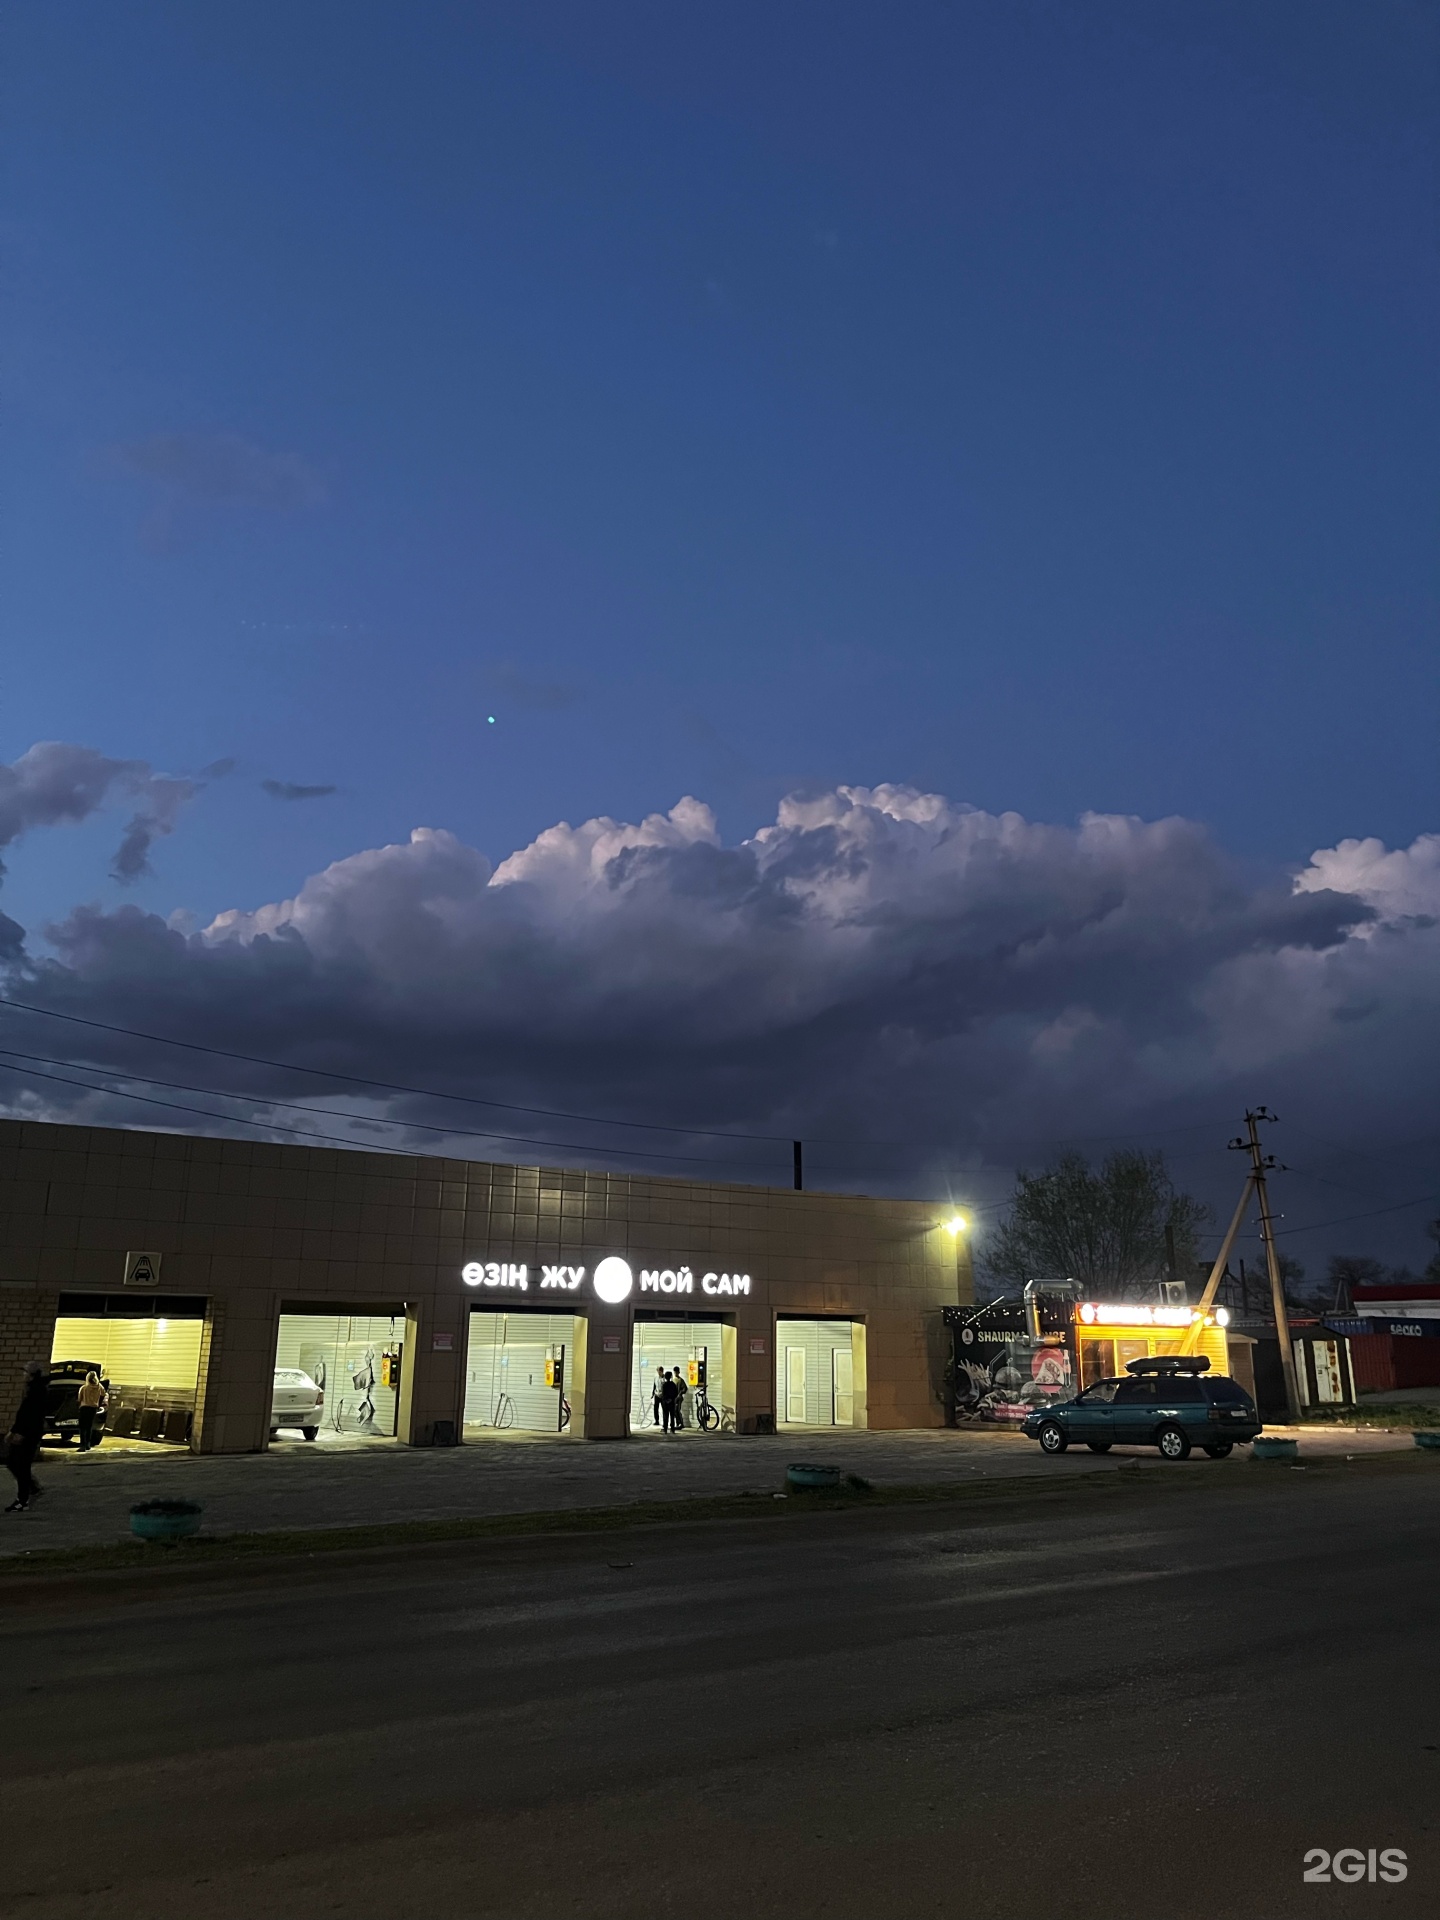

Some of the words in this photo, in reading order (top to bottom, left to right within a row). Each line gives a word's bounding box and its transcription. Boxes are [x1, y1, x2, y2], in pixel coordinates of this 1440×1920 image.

[461, 1262, 529, 1291] ӨЗІҢ
[539, 1265, 586, 1291] ЖУ
[639, 1267, 694, 1294] МОЙ
[701, 1272, 751, 1296] САМ
